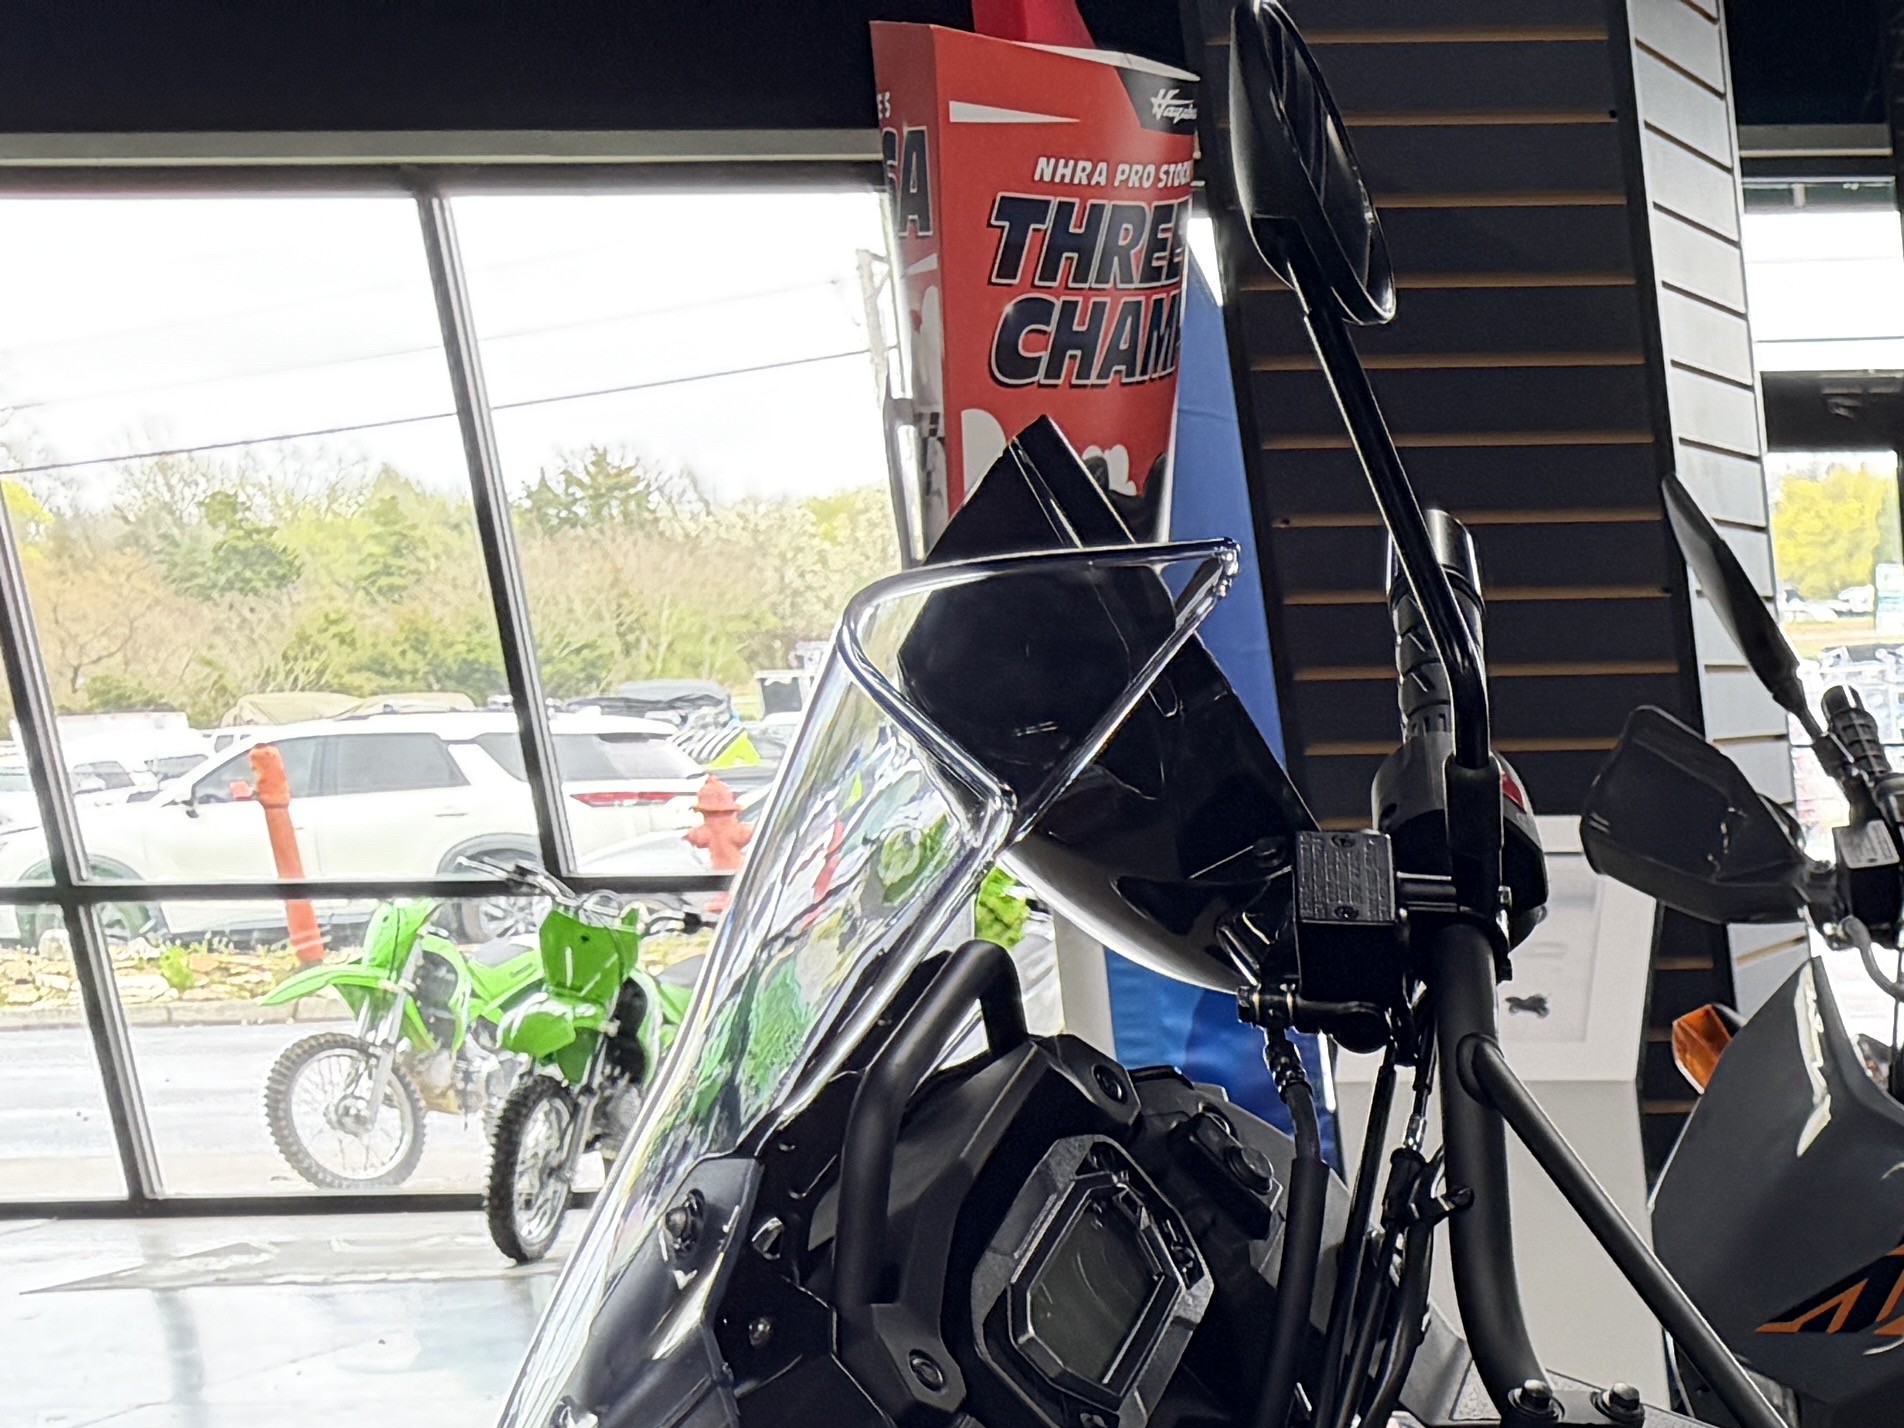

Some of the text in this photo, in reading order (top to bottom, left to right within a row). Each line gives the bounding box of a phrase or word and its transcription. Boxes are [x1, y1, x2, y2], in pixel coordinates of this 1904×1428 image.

[1034, 157, 1108, 186] NHRA
[1114, 163, 1156, 188] PRO
[989, 290, 1182, 390] CHAM
